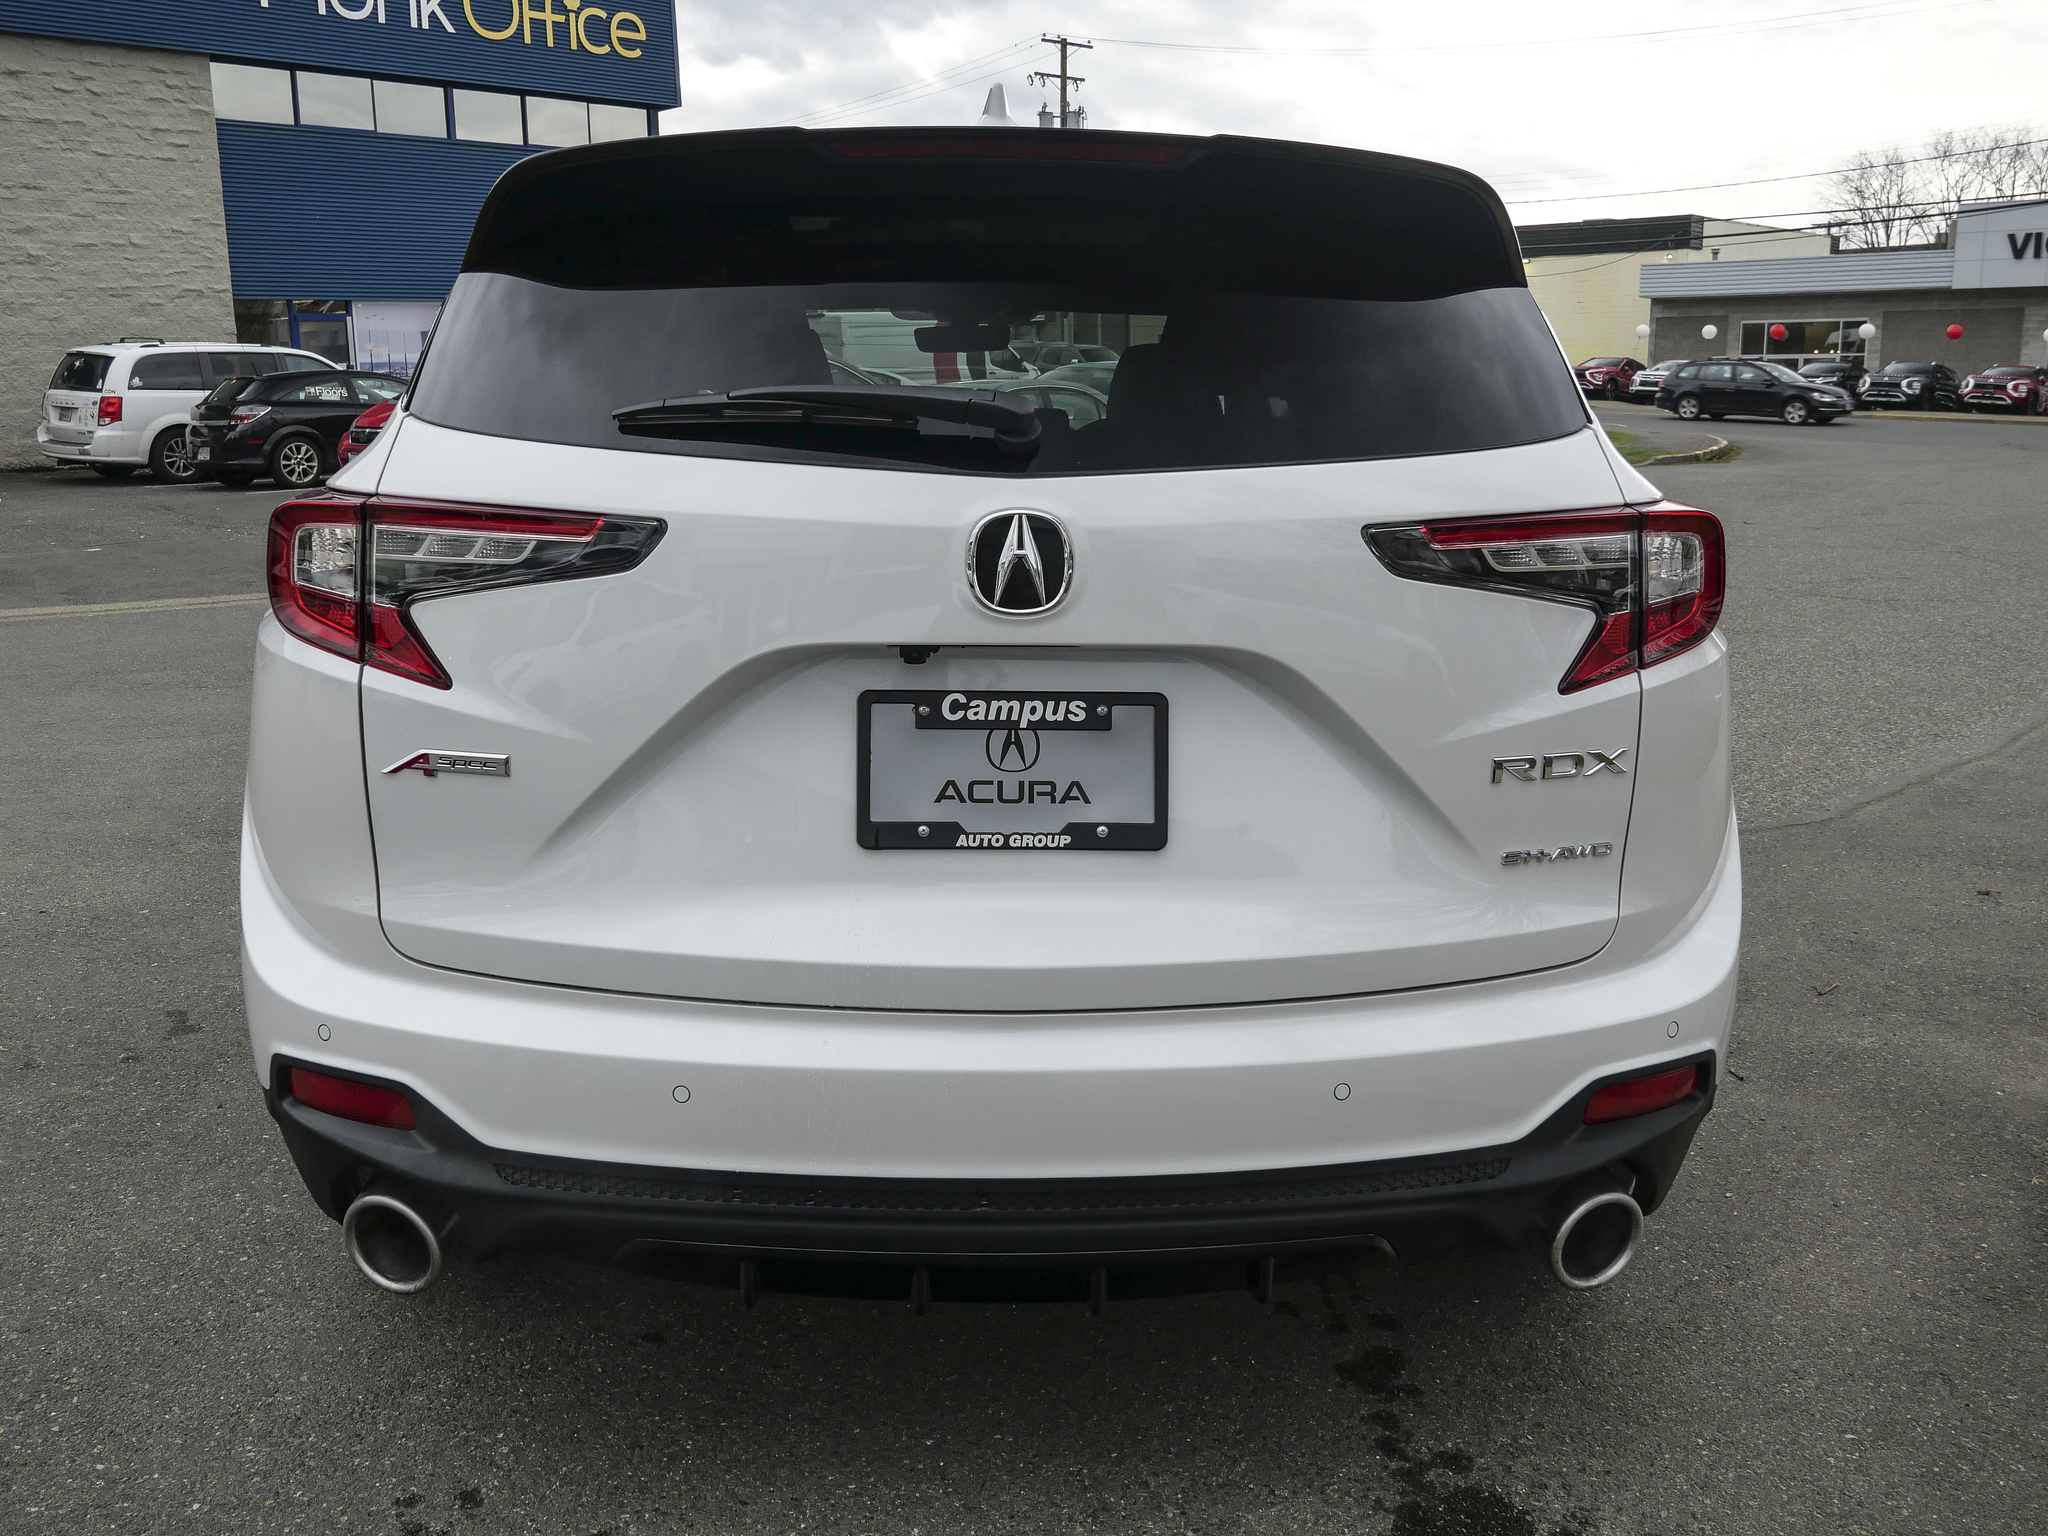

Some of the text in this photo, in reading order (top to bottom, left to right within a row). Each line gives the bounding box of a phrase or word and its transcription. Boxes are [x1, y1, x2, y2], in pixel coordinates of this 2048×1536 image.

[260, 0, 647, 59] nk Office
[2006, 231, 2048, 260] VI
[315, 386, 348, 397] Floors
[941, 692, 1087, 728] Campus
[1489, 746, 1629, 784] RDX
[933, 779, 1092, 805] ACURA
[956, 834, 1072, 848] AUTO GROUP
[1500, 841, 1614, 866] SH-AWD
